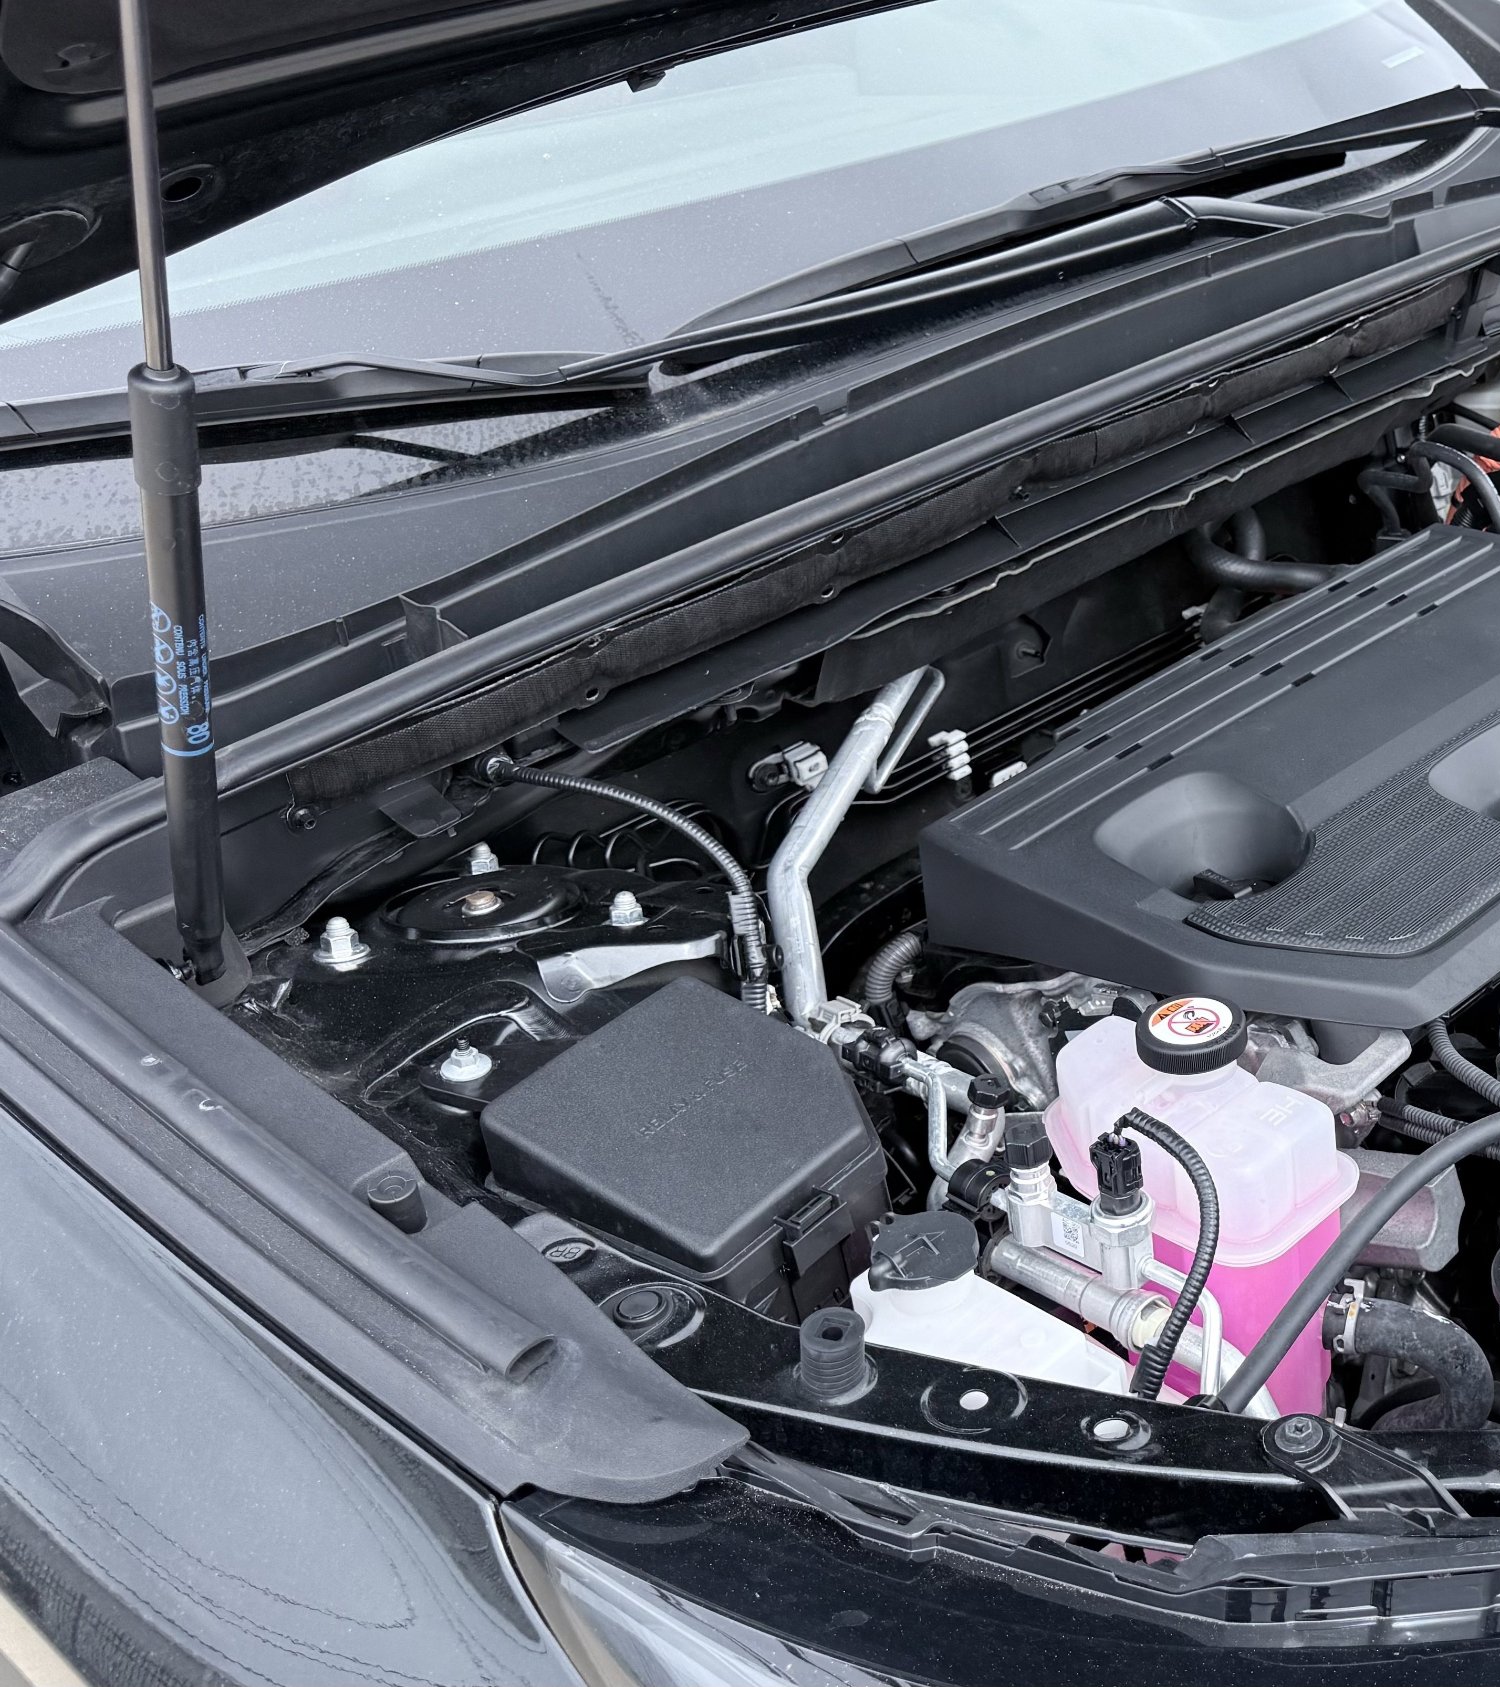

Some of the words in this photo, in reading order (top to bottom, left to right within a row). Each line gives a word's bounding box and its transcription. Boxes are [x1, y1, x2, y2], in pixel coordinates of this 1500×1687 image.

[173, 625, 186, 656] CONTENU
[176, 661, 187, 679] SOUS
[178, 685, 190, 716] PRESSION
